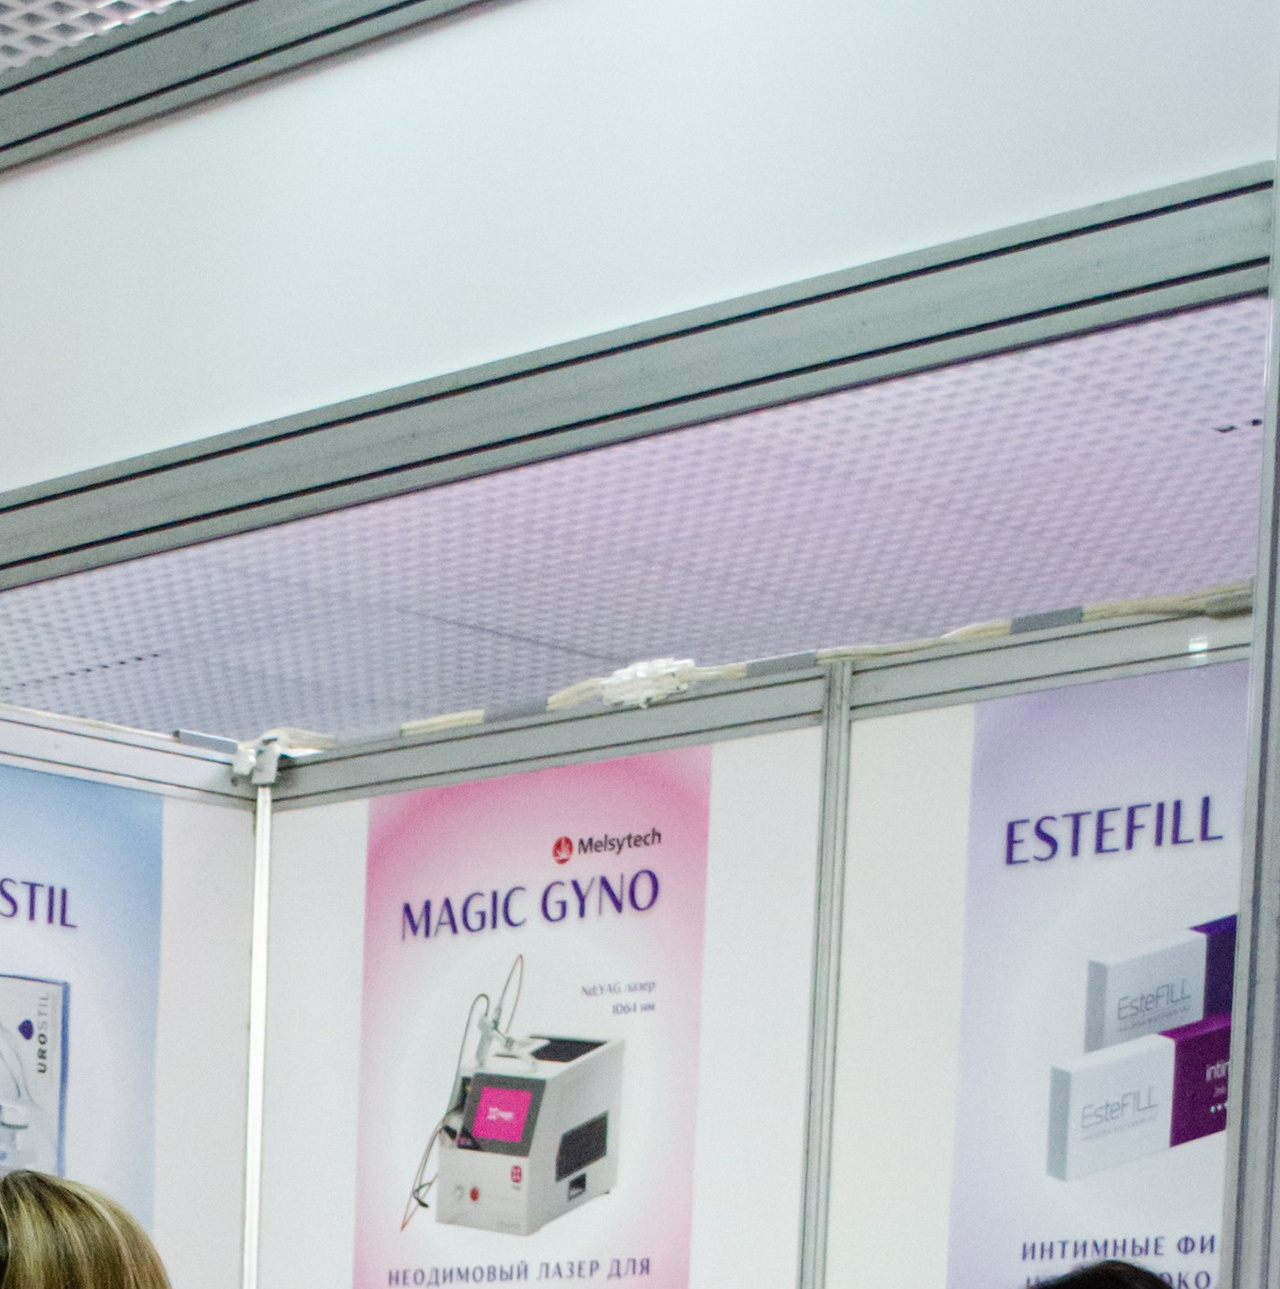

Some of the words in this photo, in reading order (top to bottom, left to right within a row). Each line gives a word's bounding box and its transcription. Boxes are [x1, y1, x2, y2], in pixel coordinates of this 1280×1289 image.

[578, 828, 662, 855] Melsytech
[1005, 795, 1224, 866] ESTEFILL
[402, 885, 527, 941] MAGIC
[540, 868, 660, 923] GYNO
[1116, 978, 1192, 1021] EsteFILL
[36, 992, 50, 1075] UROSTIL
[1080, 1086, 1159, 1131] EsteFILL
[1021, 1236, 1166, 1261] ИНТИМНЫЕ
[388, 1260, 529, 1288] НЕОДИМОВЫЙ
[535, 1259, 601, 1282] ЛАЗЕР
[607, 1257, 651, 1280] ДЛЯ
